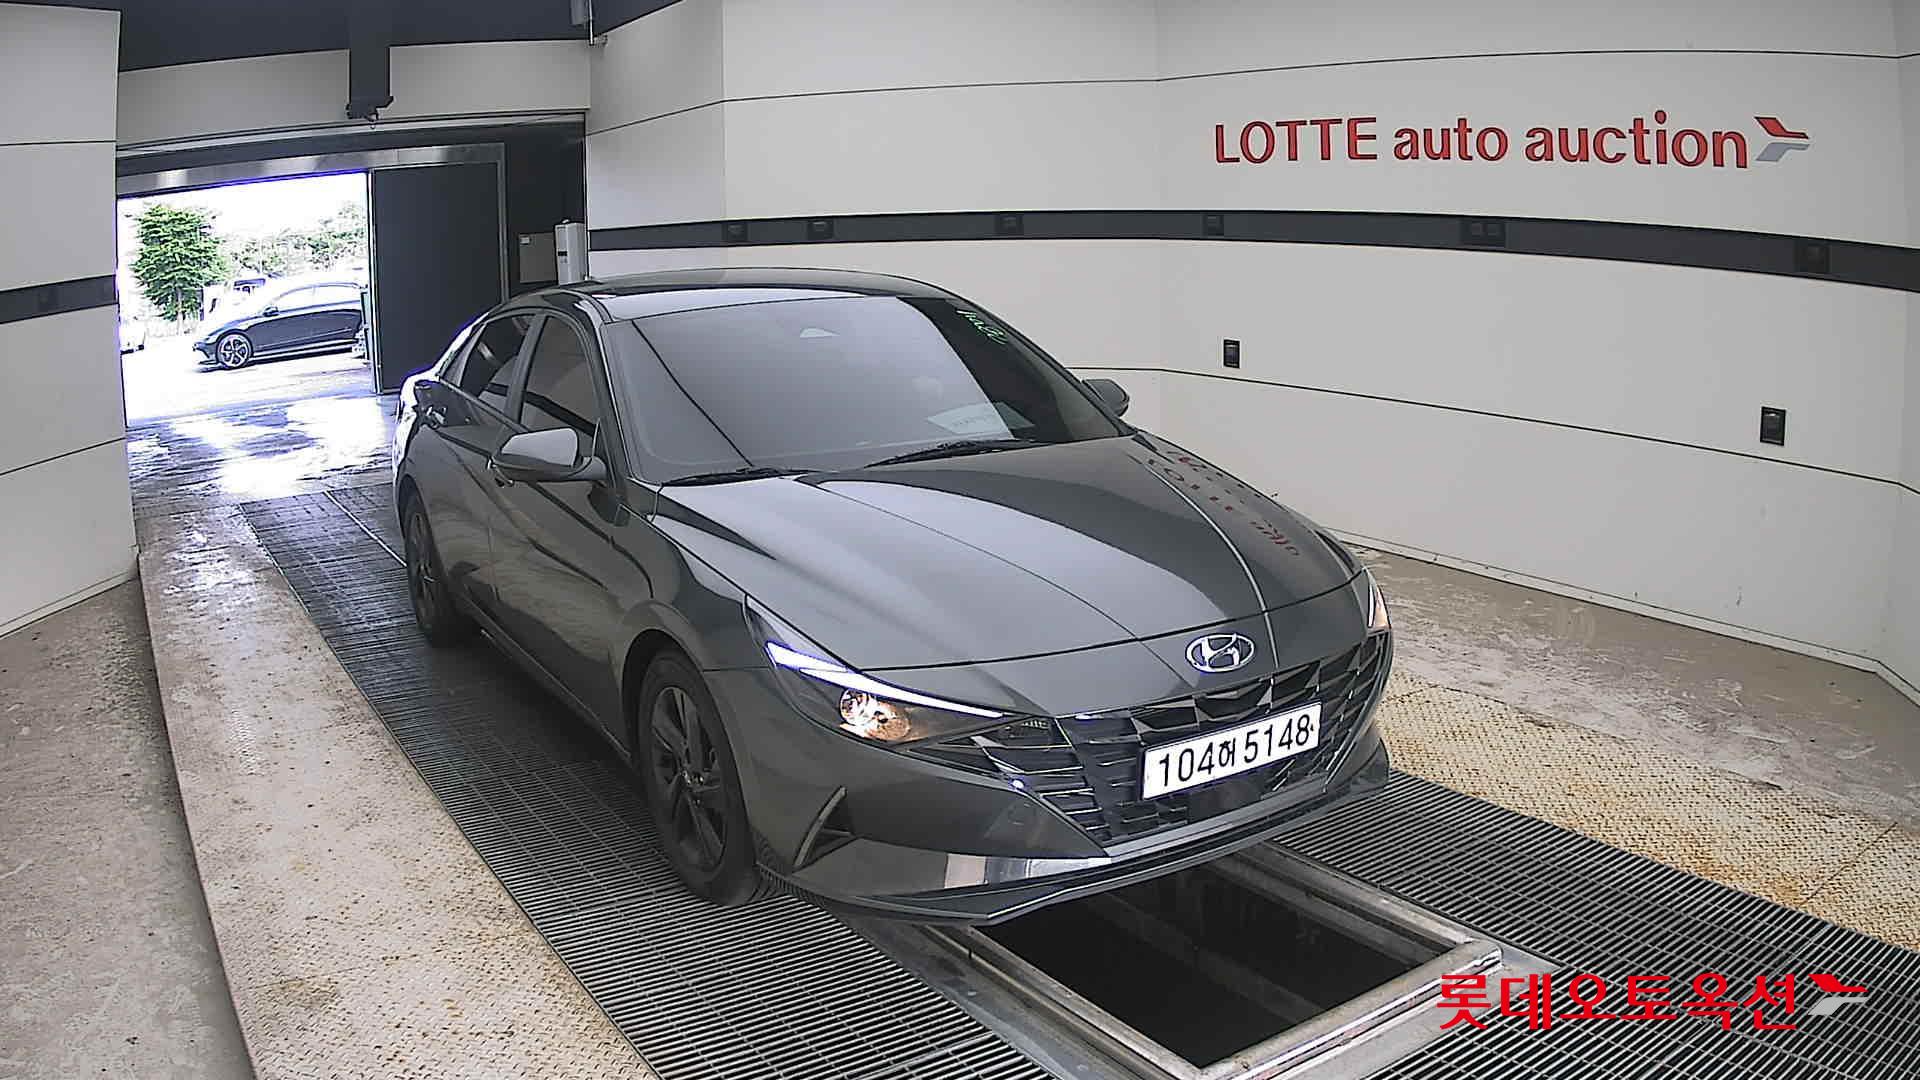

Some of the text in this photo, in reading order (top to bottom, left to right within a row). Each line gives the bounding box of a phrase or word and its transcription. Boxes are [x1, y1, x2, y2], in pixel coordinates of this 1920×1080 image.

[1215, 109, 1749, 169] LOTTE auto auction
